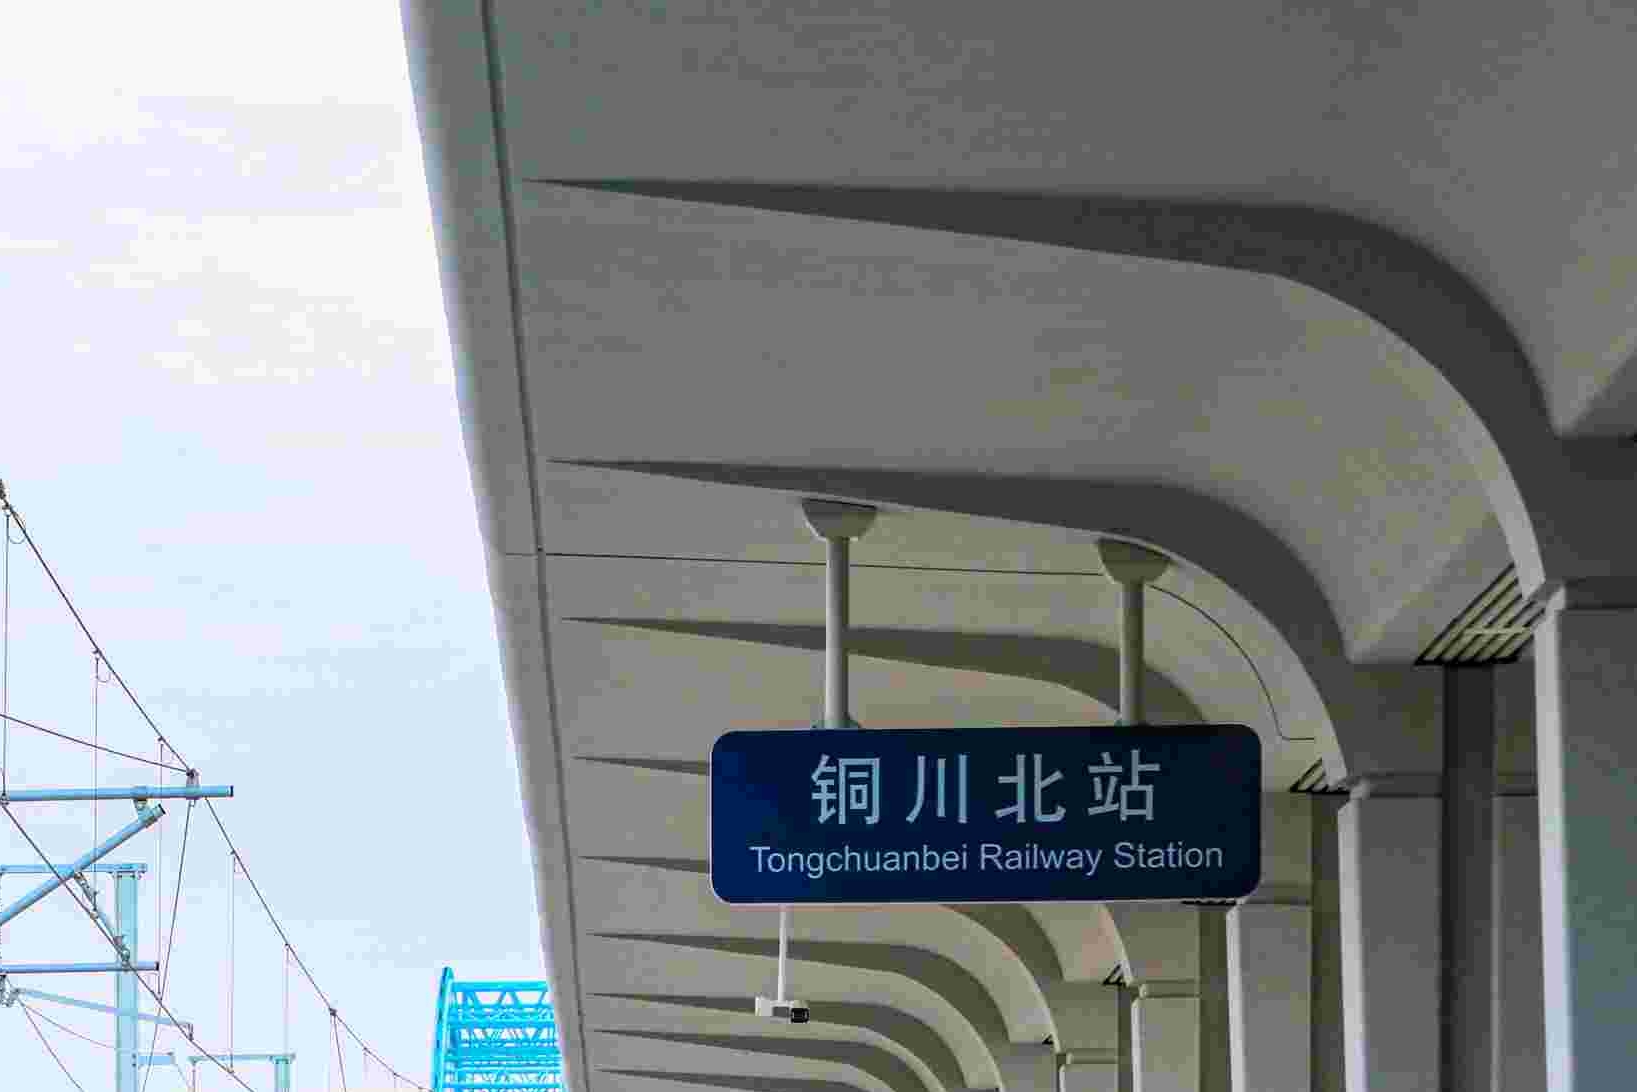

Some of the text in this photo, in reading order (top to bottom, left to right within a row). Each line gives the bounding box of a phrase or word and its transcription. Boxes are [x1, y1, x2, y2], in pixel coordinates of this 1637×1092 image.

[810, 749, 1161, 825] 铜川北站
[749, 841, 1224, 878] Tongchuanbei Railway Station
